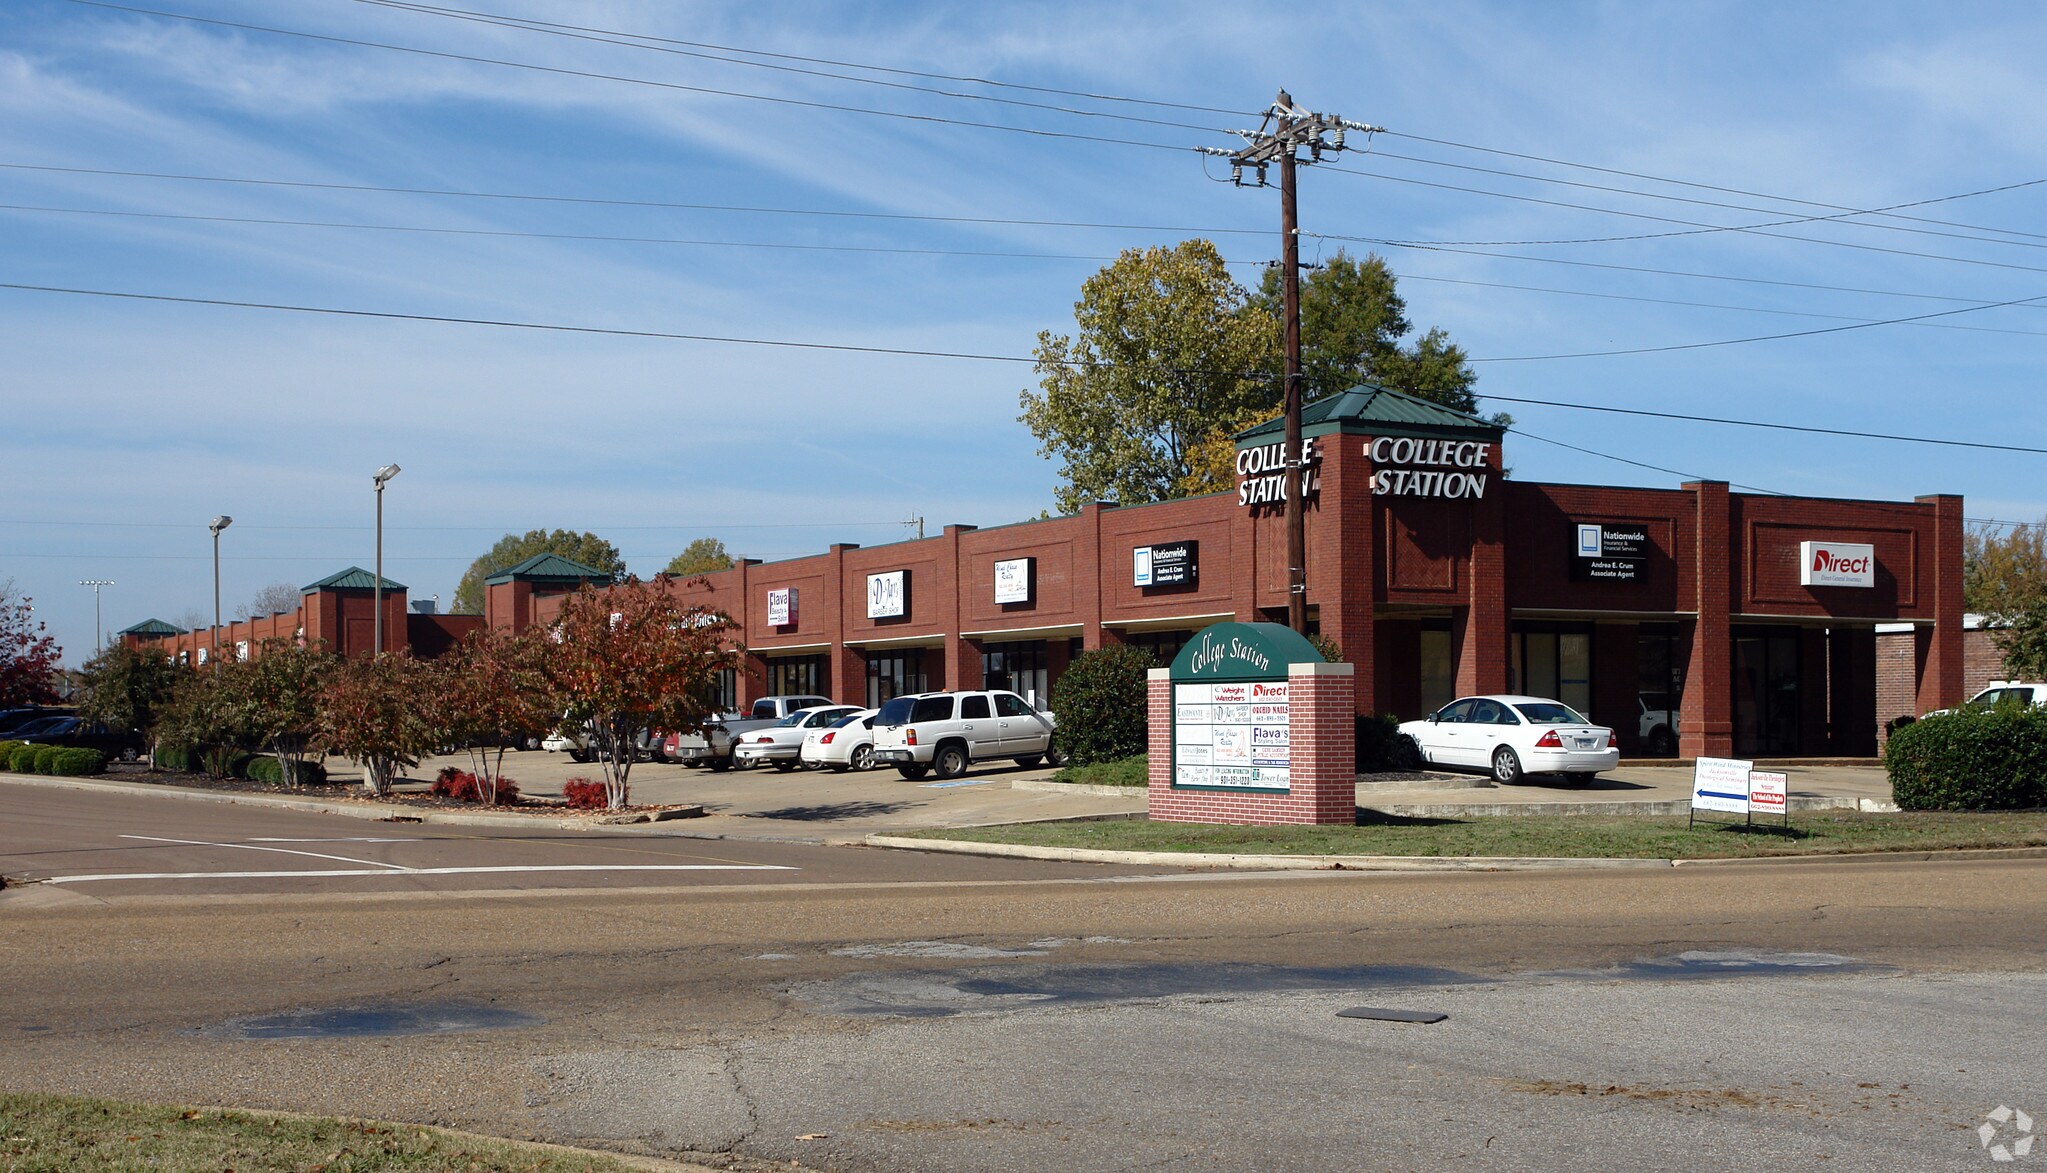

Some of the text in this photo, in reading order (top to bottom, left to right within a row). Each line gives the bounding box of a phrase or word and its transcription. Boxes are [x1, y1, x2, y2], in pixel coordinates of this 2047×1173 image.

[1236, 438, 1313, 476] COLLEE
[1371, 437, 1491, 467] COLLEGE
[1238, 470, 1310, 506] STATIN
[1375, 469, 1487, 499] STATION
[1603, 531, 1645, 541] Nationwide
[1152, 546, 1187, 560] Nationwide
[1812, 549, 1869, 574] Direct
[1617, 571, 1635, 579] Agent
[769, 592, 788, 615] Flava
[1191, 632, 1269, 674] College Station
[1214, 694, 1245, 702] Watchers
[1222, 687, 1245, 695] Weight
[1253, 684, 1287, 697] Direct
[1272, 705, 1289, 714] NAILS
[1253, 727, 1289, 743] Flava's
